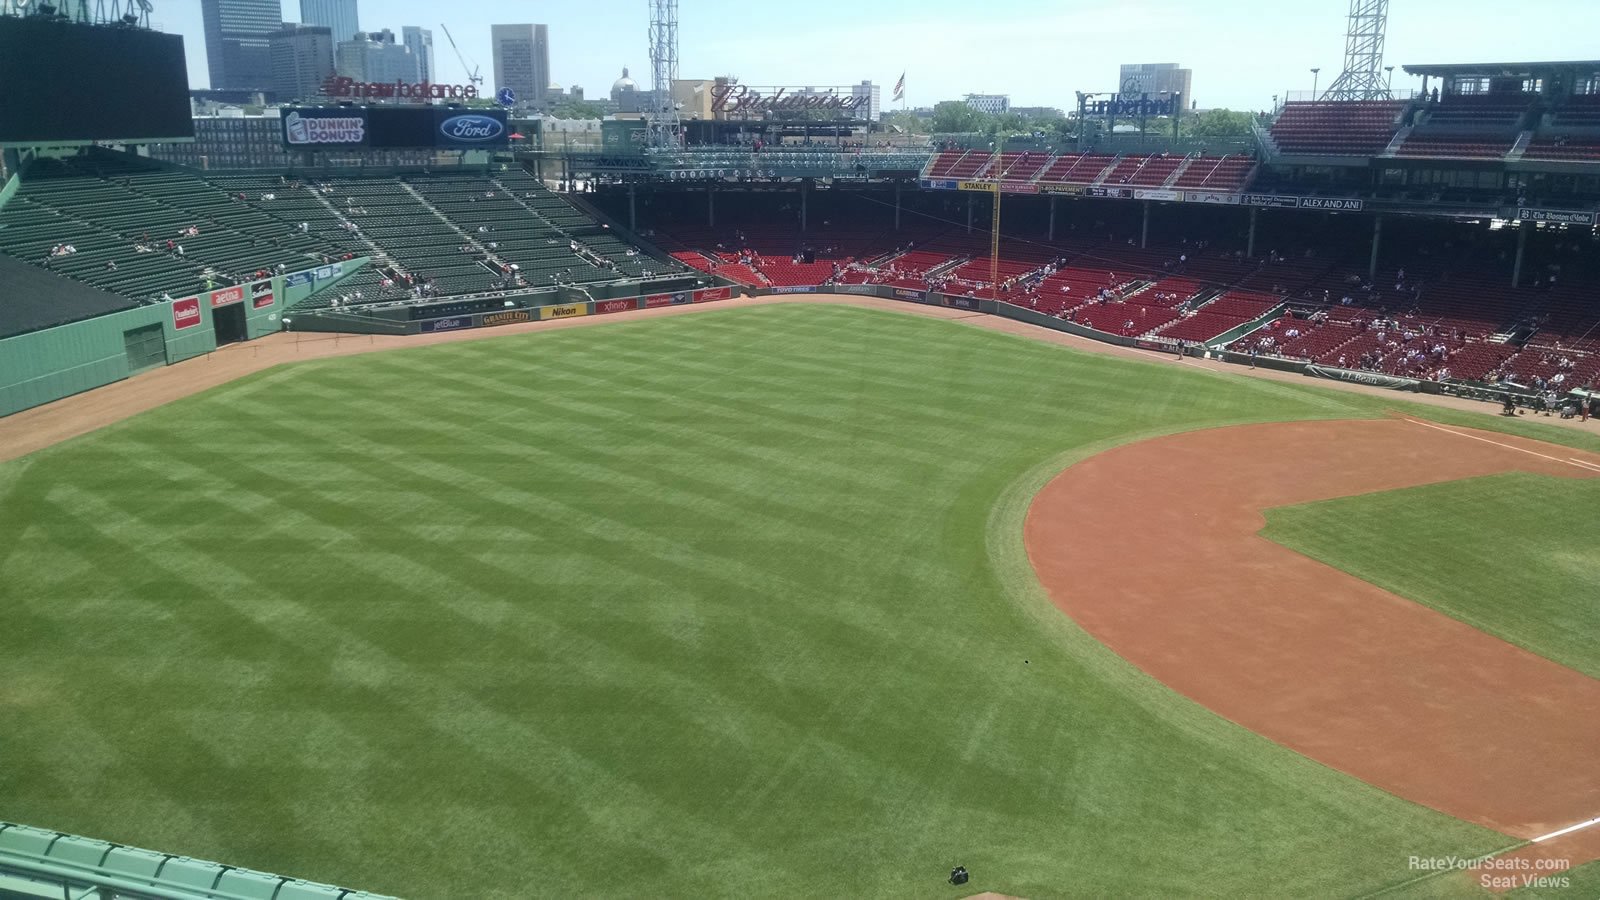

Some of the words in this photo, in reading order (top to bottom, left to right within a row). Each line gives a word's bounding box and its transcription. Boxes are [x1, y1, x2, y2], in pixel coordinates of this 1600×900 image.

[352, 82, 396, 97] new
[397, 79, 476, 97] balance
[710, 84, 870, 113] Budweiser
[308, 119, 362, 130] DUNKIN'
[453, 118, 491, 137] Ford
[309, 130, 361, 141] DONUTS
[965, 182, 993, 190] STANLEY
[1303, 199, 1322, 207] ALEX
[1323, 200, 1342, 208] AND
[1343, 201, 1359, 209] ANI
[1532, 211, 1545, 219] The
[1545, 212, 1569, 221] Boston
[1569, 213, 1590, 222] Globe
[215, 290, 240, 304] aetna
[604, 300, 629, 311] xfinity
[484, 312, 513, 324] GRANITE
[514, 311, 529, 320] CITY
[552, 307, 576, 317] Nikon
[433, 318, 460, 331] jetBlue
